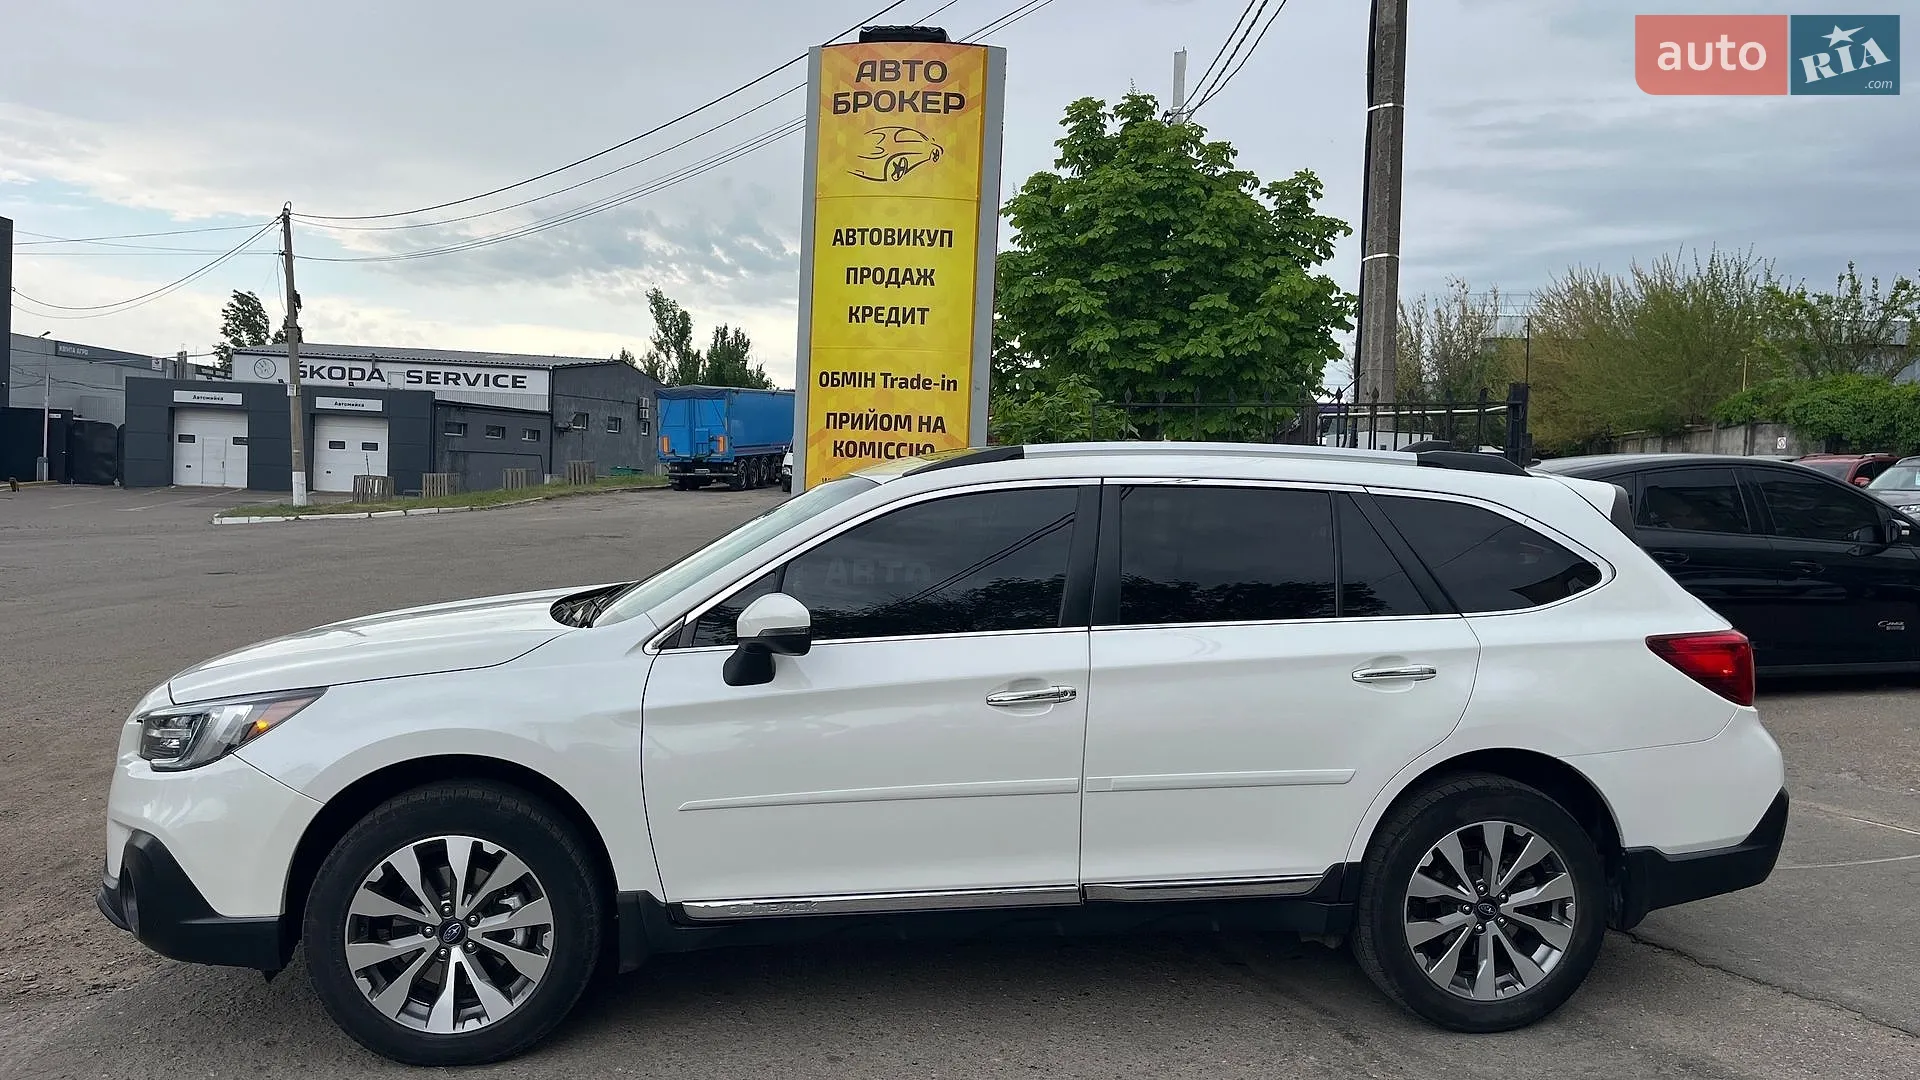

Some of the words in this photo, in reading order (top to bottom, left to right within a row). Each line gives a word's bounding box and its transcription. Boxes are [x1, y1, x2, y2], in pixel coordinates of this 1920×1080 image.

[855, 60, 948, 83] АВТО
[832, 90, 965, 114] БРОКЕР
[832, 227, 953, 248] АВТОВИКУП
[845, 267, 936, 289] ПРОДАЖ
[848, 305, 930, 327] КРЕДИТ
[406, 370, 527, 389] SERVICE
[819, 371, 876, 388] ОБМІН
[880, 372, 958, 392] Trade-in
[826, 409, 912, 432] ПРИЙОМ
[918, 415, 946, 433] НА
[833, 440, 935, 459] КОМІССІЮ
[728, 902, 819, 916] OUTBACK
